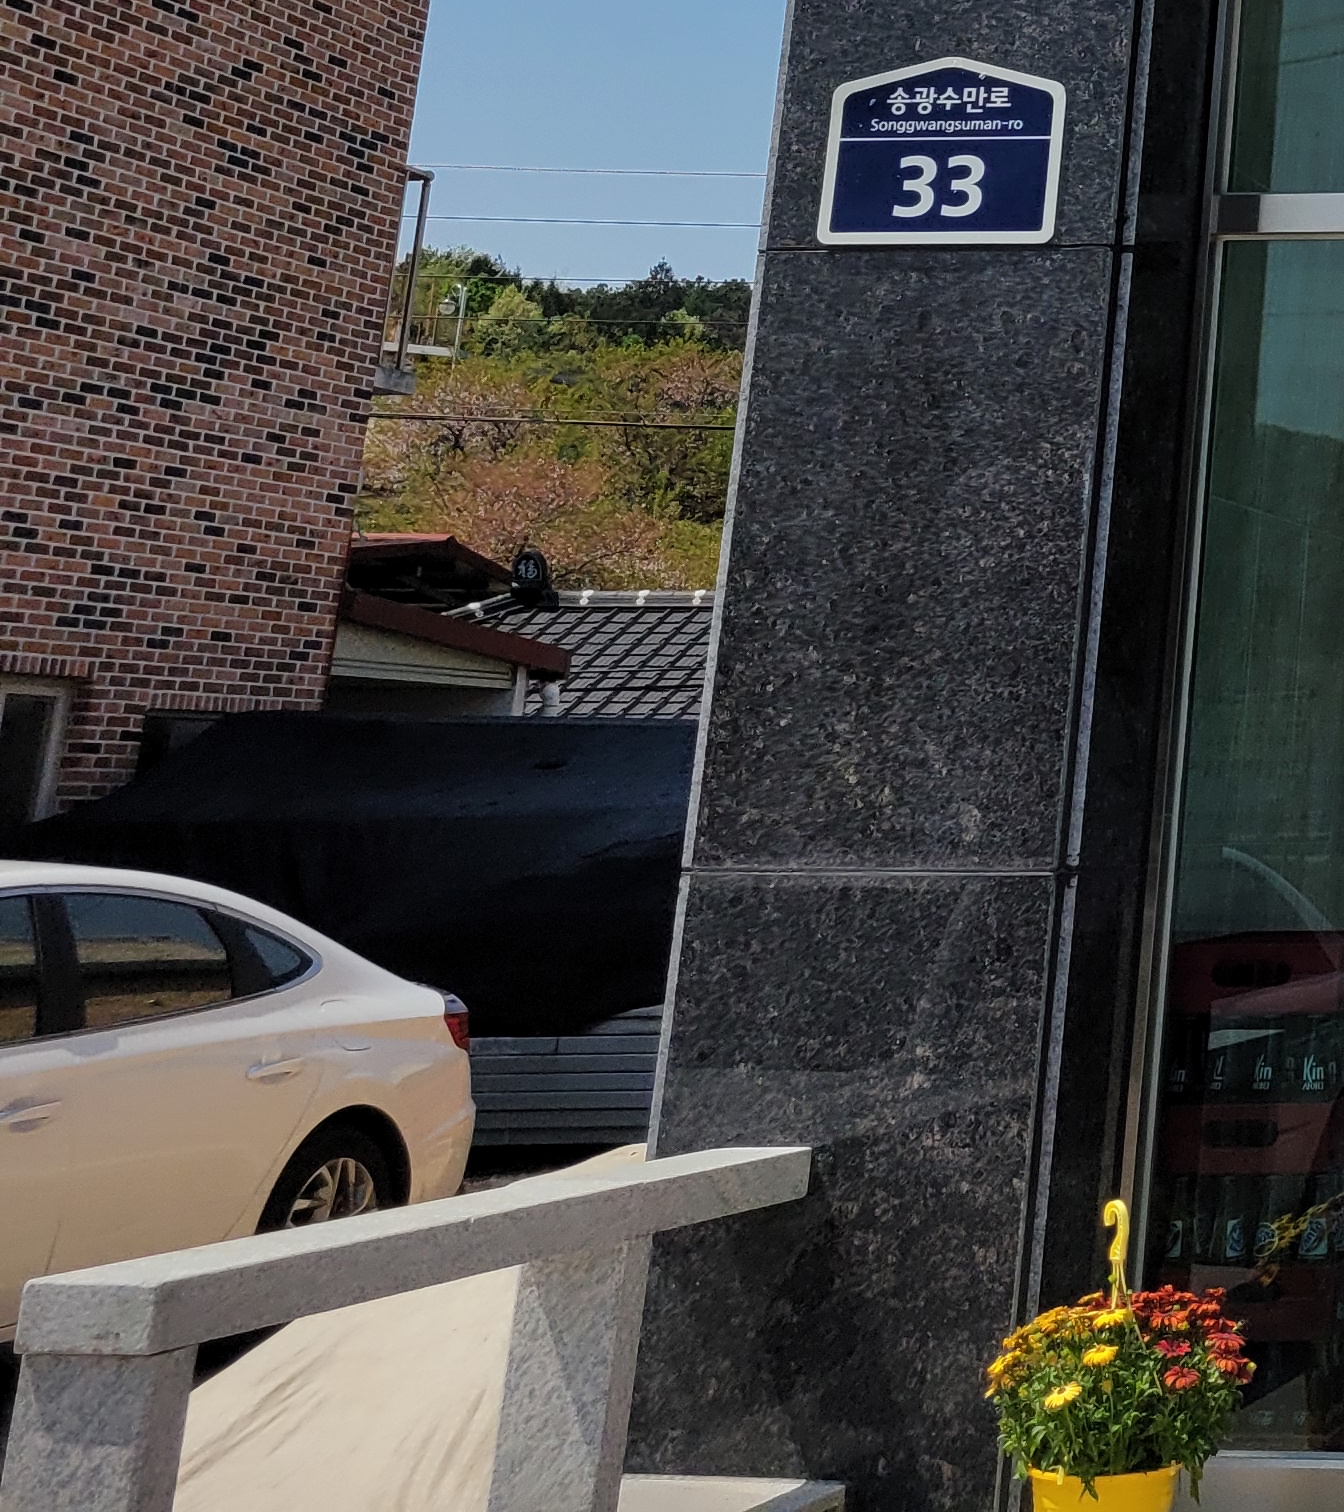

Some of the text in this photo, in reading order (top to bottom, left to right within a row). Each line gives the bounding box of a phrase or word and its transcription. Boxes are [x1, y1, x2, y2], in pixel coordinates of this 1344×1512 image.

[886, 86, 1012, 115] 송광수만로
[870, 118, 1024, 133] Songgwangsuman-ro
[891, 154, 986, 218] 33
[1302, 1053, 1325, 1083] Kin
